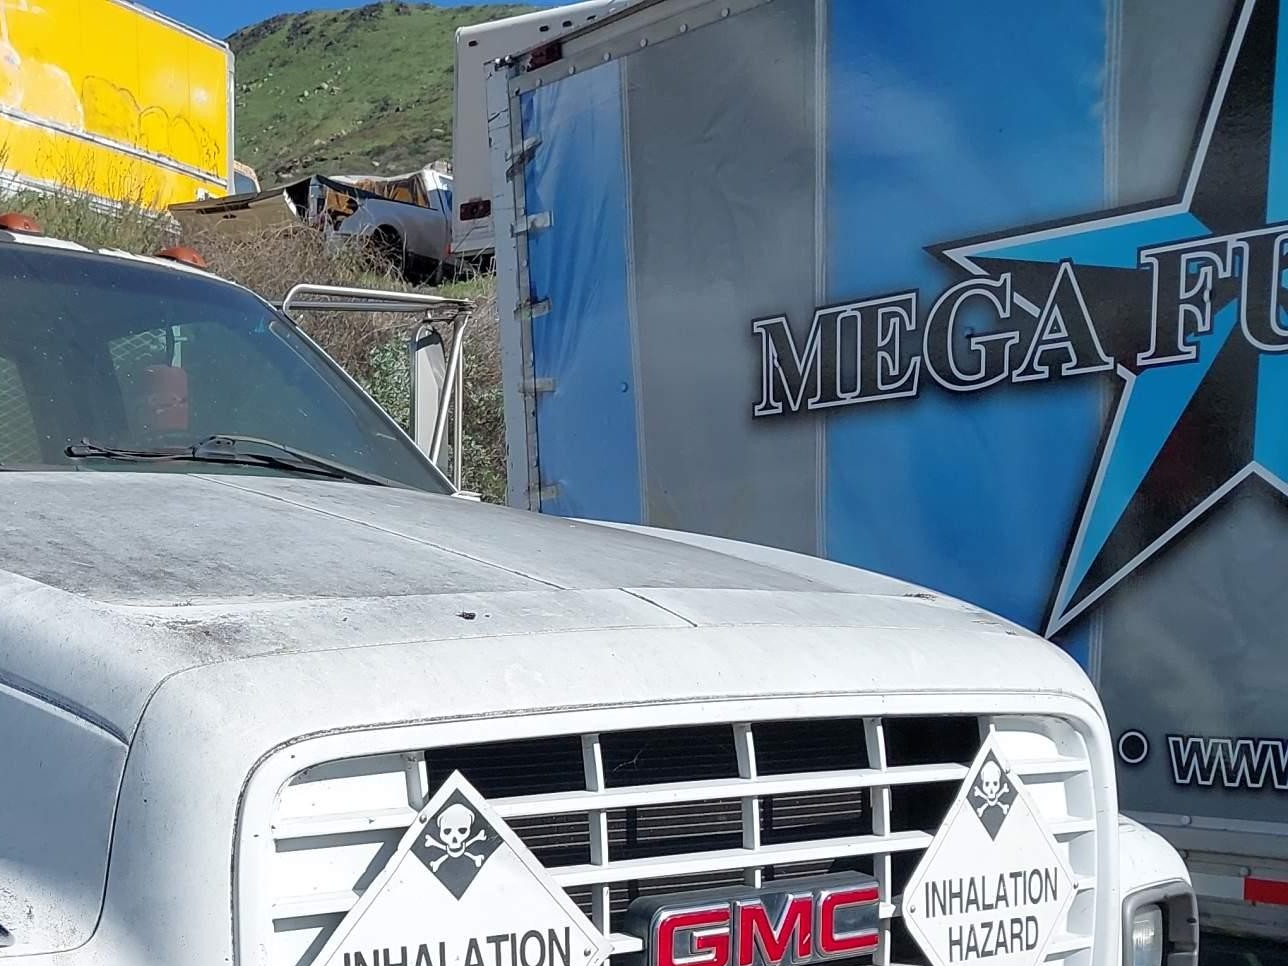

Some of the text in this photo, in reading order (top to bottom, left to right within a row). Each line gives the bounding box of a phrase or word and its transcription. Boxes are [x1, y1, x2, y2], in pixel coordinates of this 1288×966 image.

[753, 260, 1114, 416] MEGA
[924, 868, 1058, 912] INHALATION
[948, 914, 1040, 963] HAZARD
